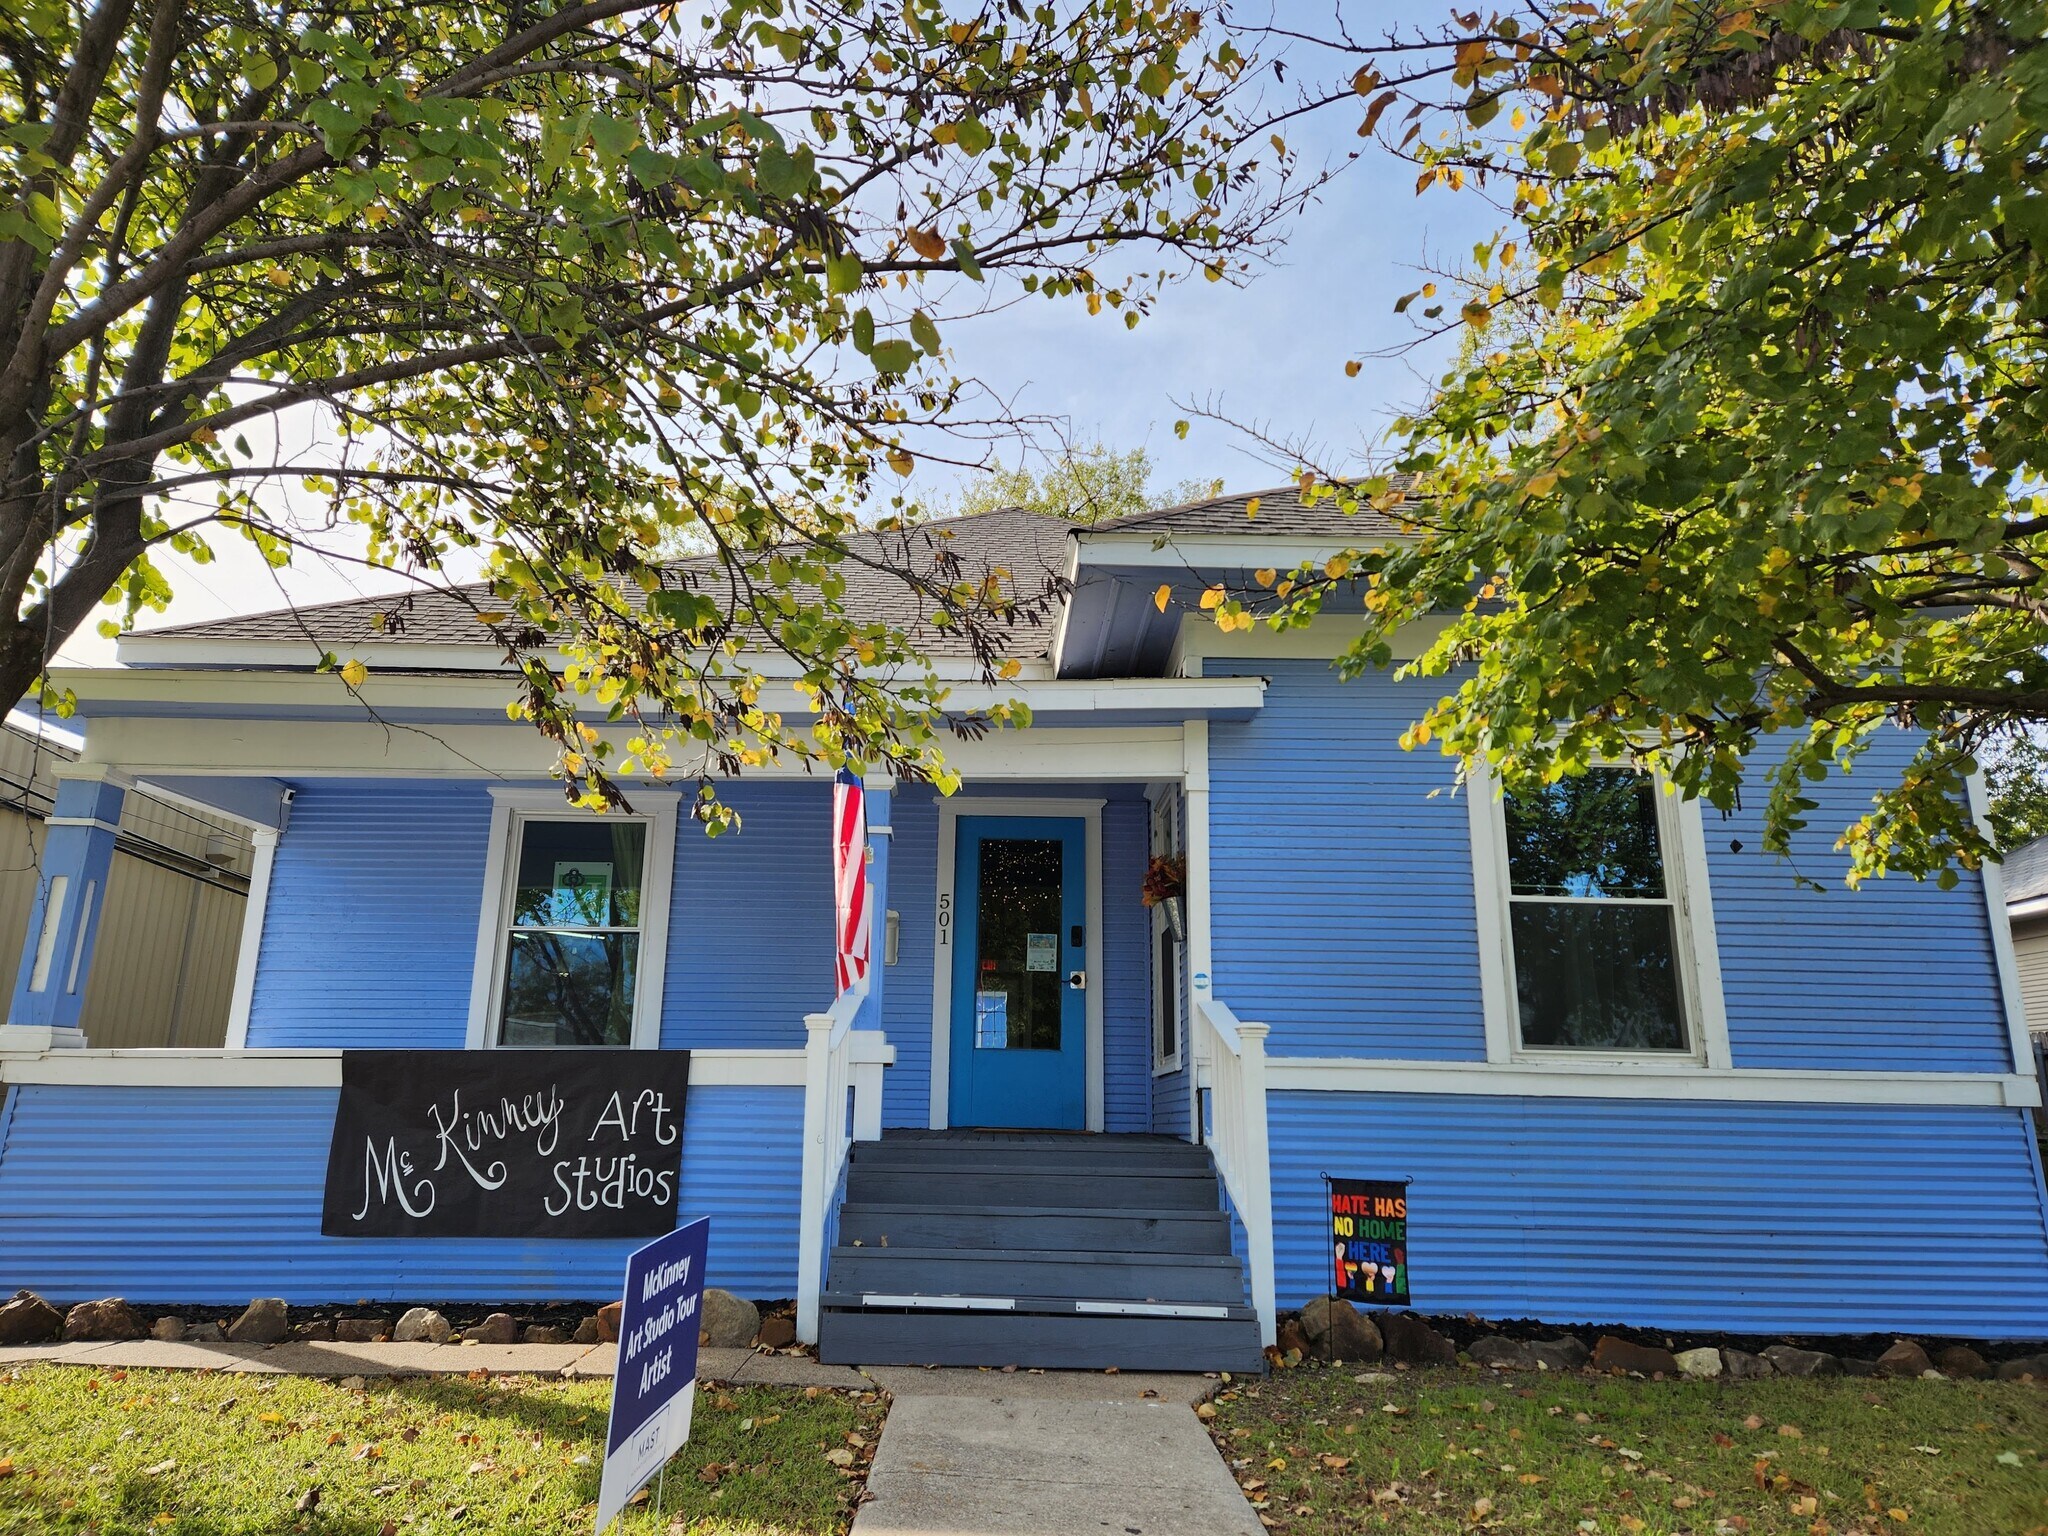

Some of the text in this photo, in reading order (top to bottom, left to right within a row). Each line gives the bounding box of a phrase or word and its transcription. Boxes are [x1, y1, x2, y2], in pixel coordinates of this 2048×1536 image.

[939, 893, 950, 945] 501
[588, 1089, 676, 1146] Art
[544, 1153, 675, 1216] Studios
[1332, 1194, 1407, 1218] HATE HAS
[1334, 1216, 1405, 1240] NO HOME
[1348, 1240, 1392, 1264] HERE
[642, 1255, 691, 1303] McKinney
[625, 1293, 698, 1364] Art Studio Tour
[638, 1344, 673, 1399] Artist
[638, 1426, 660, 1461] MAST
